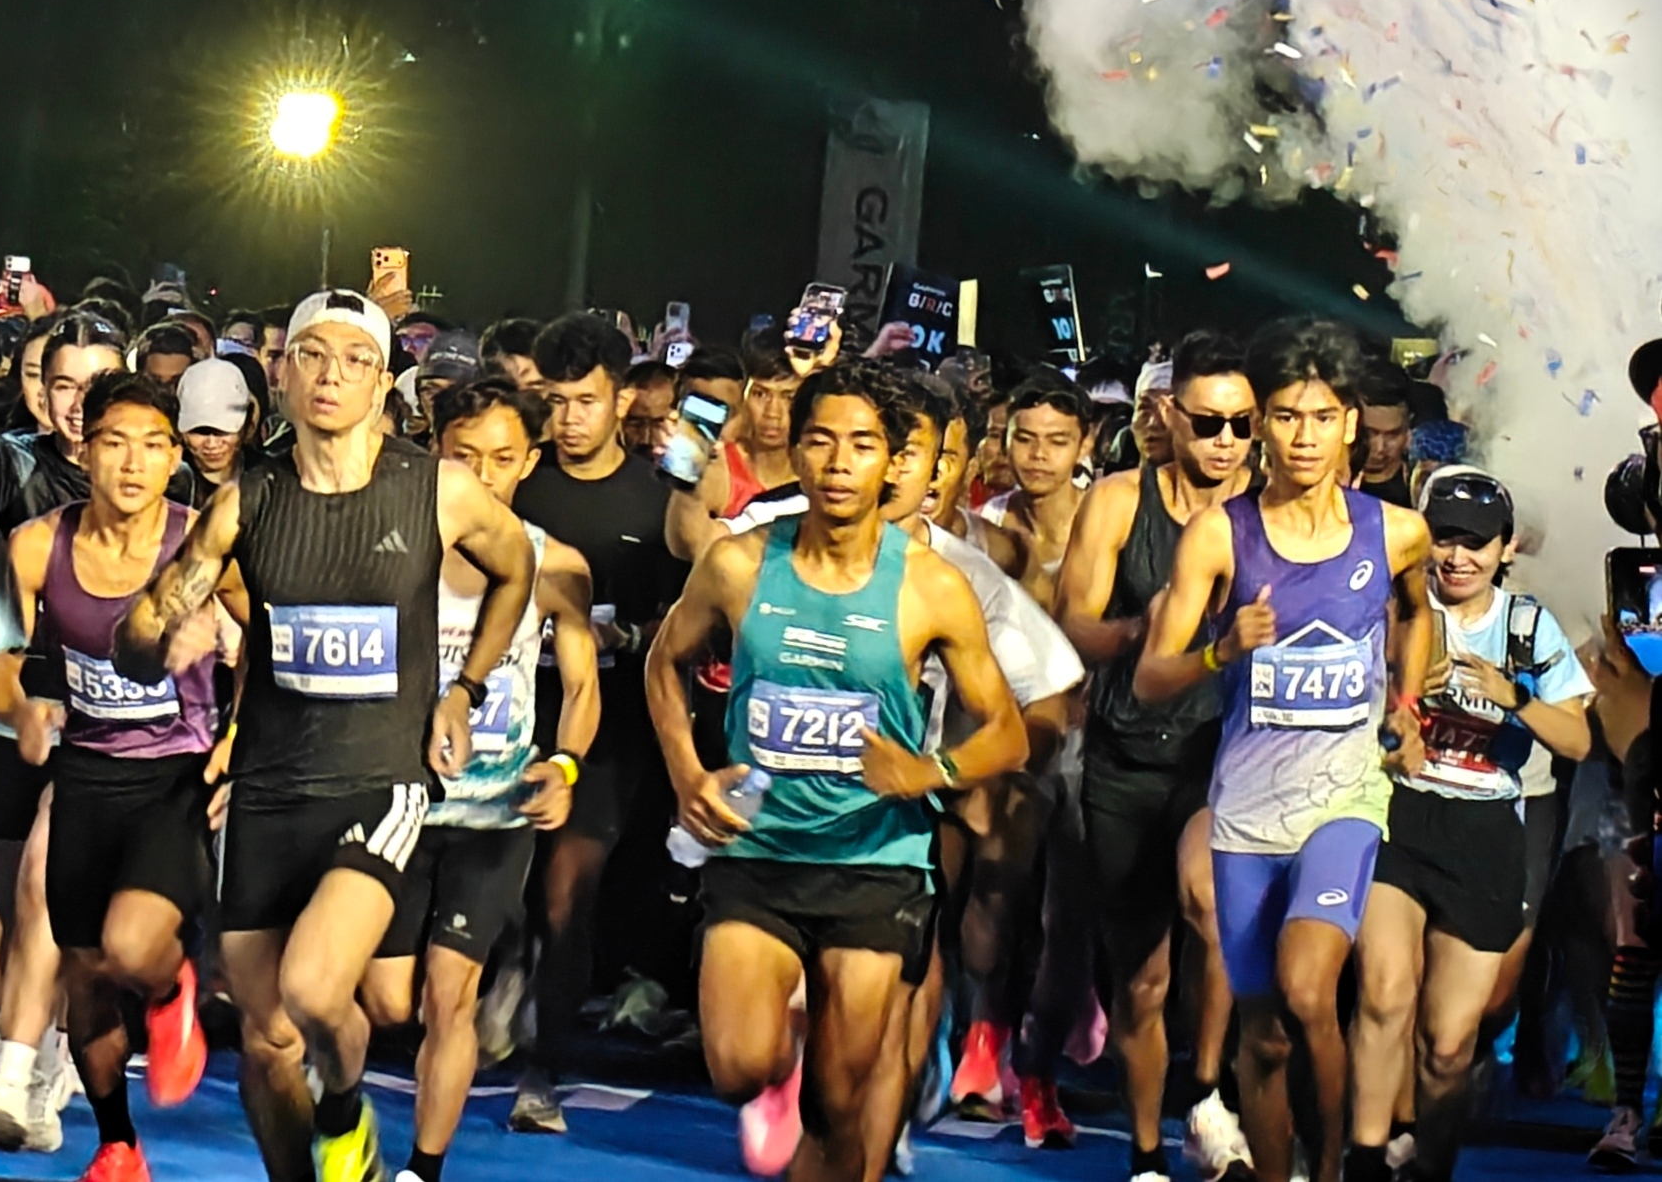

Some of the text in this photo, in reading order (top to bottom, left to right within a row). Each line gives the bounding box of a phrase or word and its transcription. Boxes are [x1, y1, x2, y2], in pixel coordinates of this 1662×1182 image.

[910, 323, 946, 355] 0K
[302, 626, 386, 667] 7614
[1282, 659, 1366, 701] 7473
[779, 706, 866, 747] 7212
